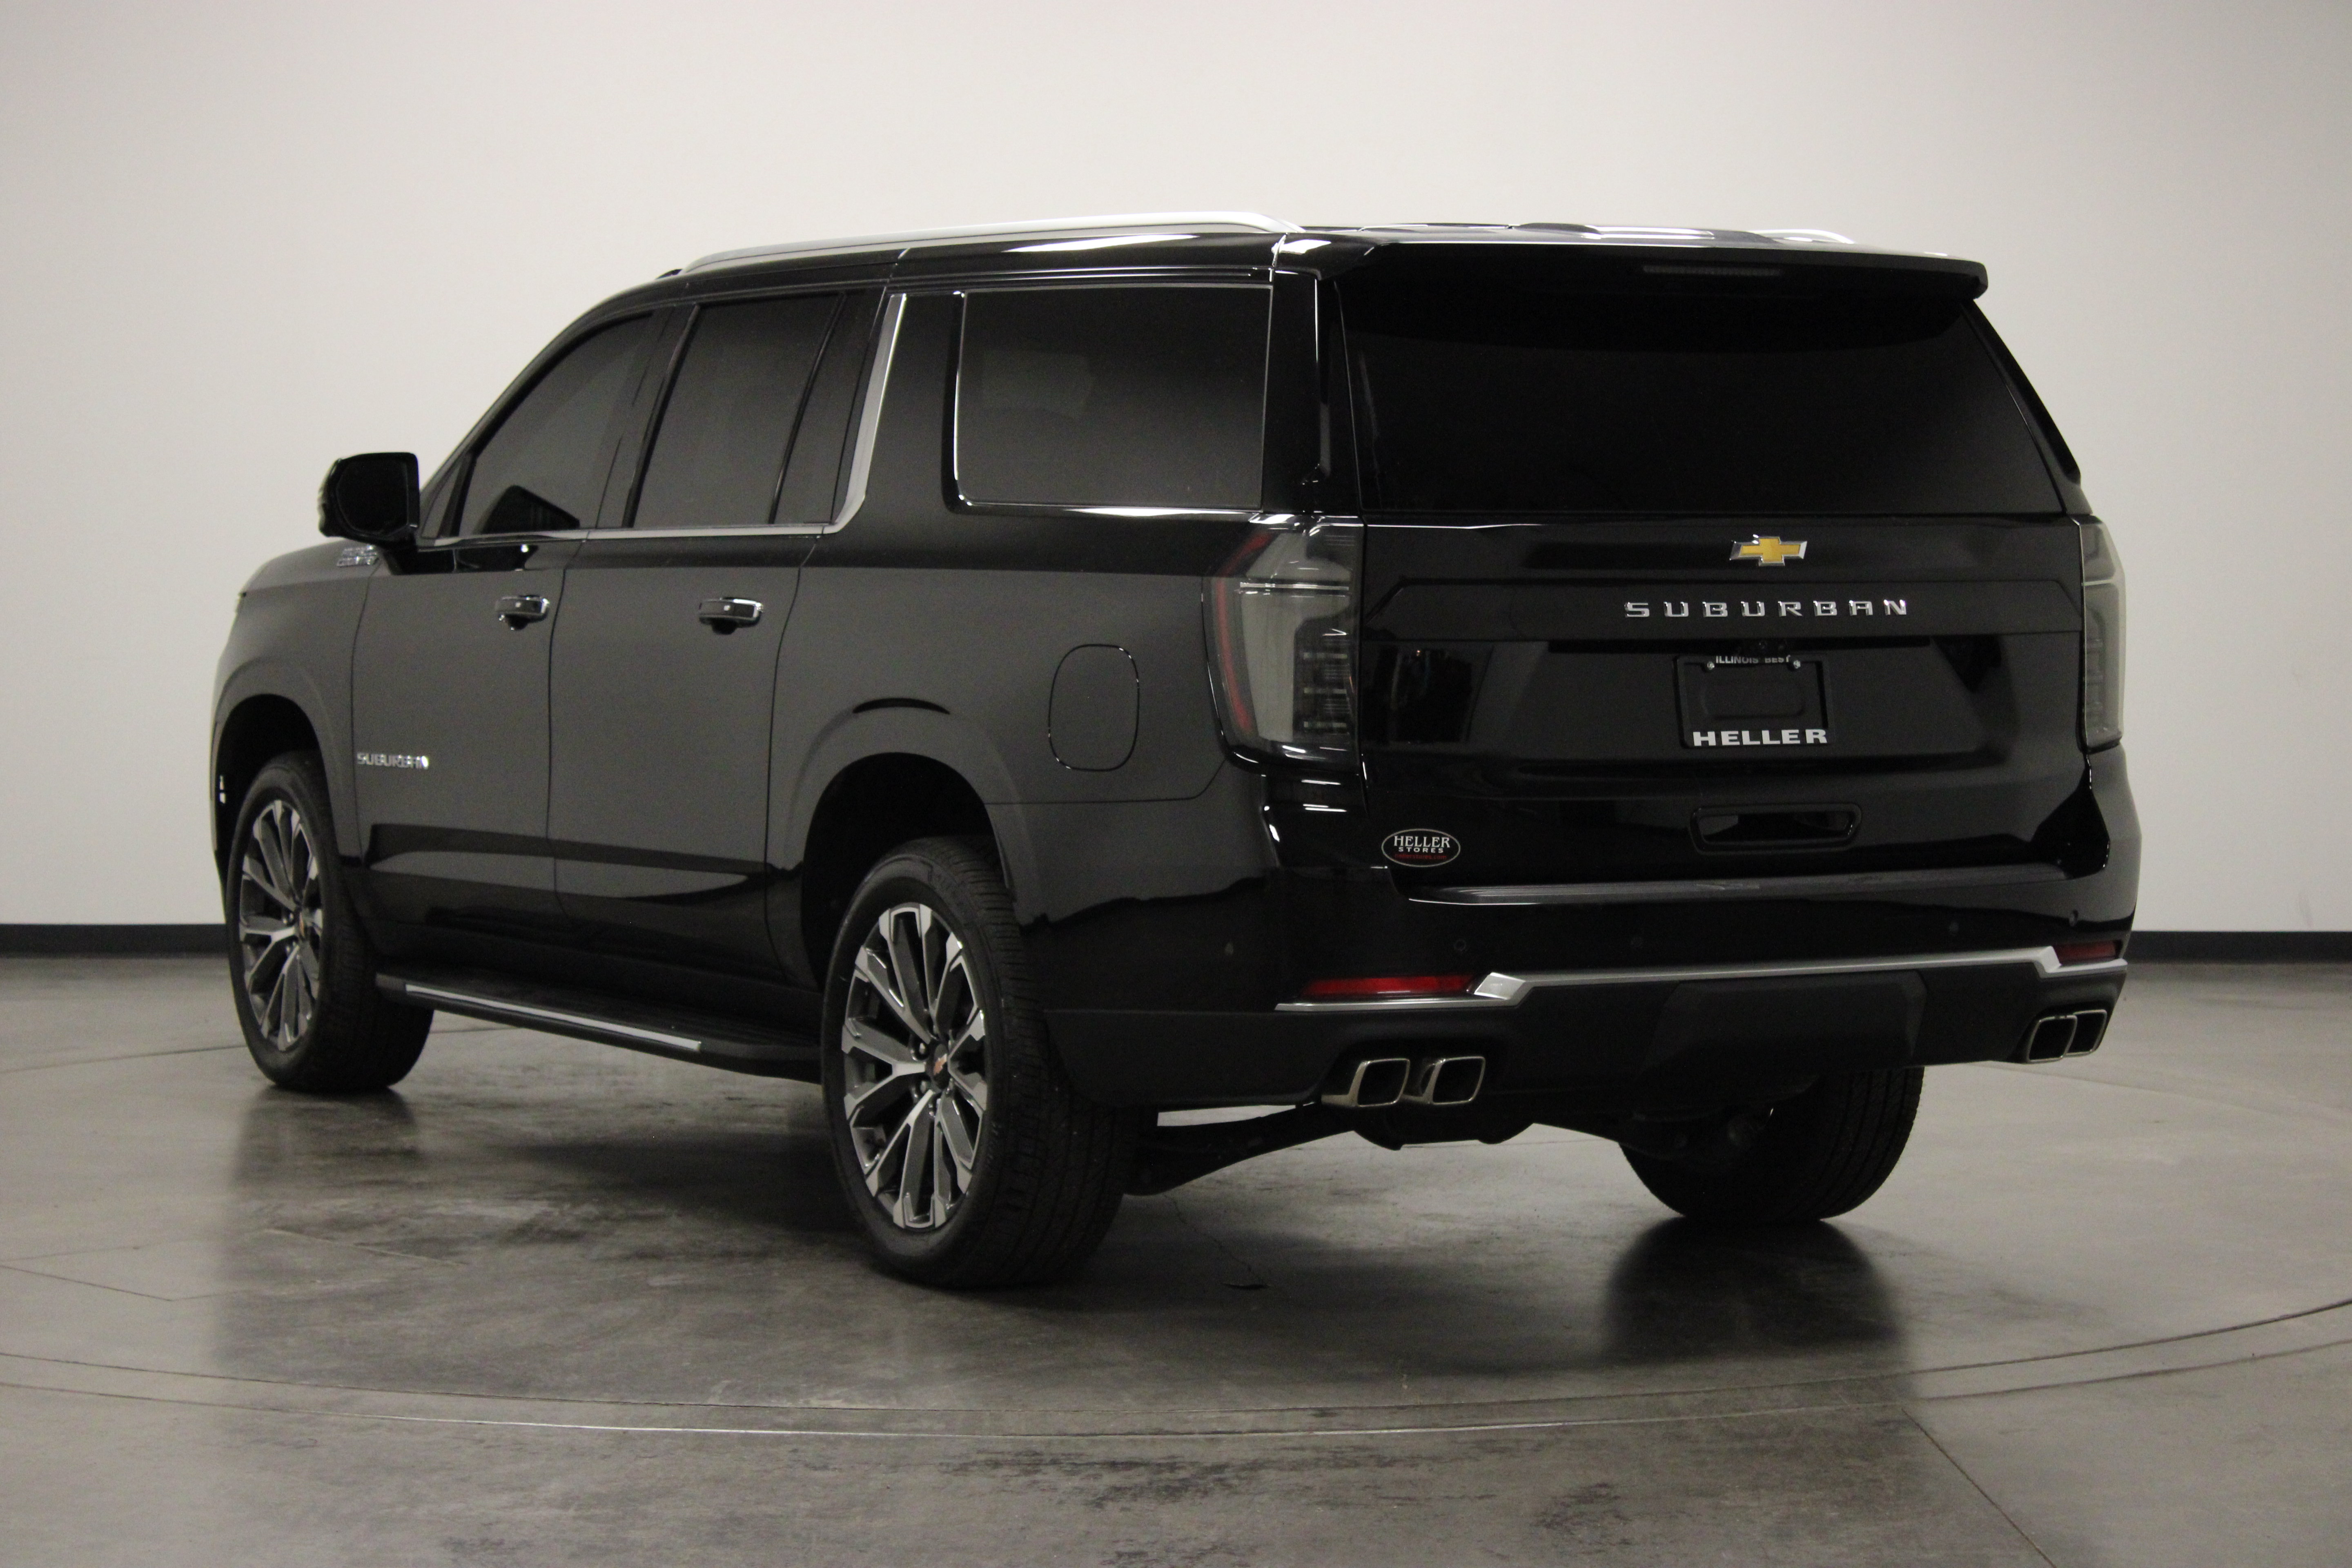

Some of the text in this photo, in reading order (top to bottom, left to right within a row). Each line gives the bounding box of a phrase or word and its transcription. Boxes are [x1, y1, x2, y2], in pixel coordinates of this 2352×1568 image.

[1624, 599, 1907, 617] SUBURBAN
[1693, 729, 1827, 746] HELLER
[1394, 835, 1450, 848] HELLER
